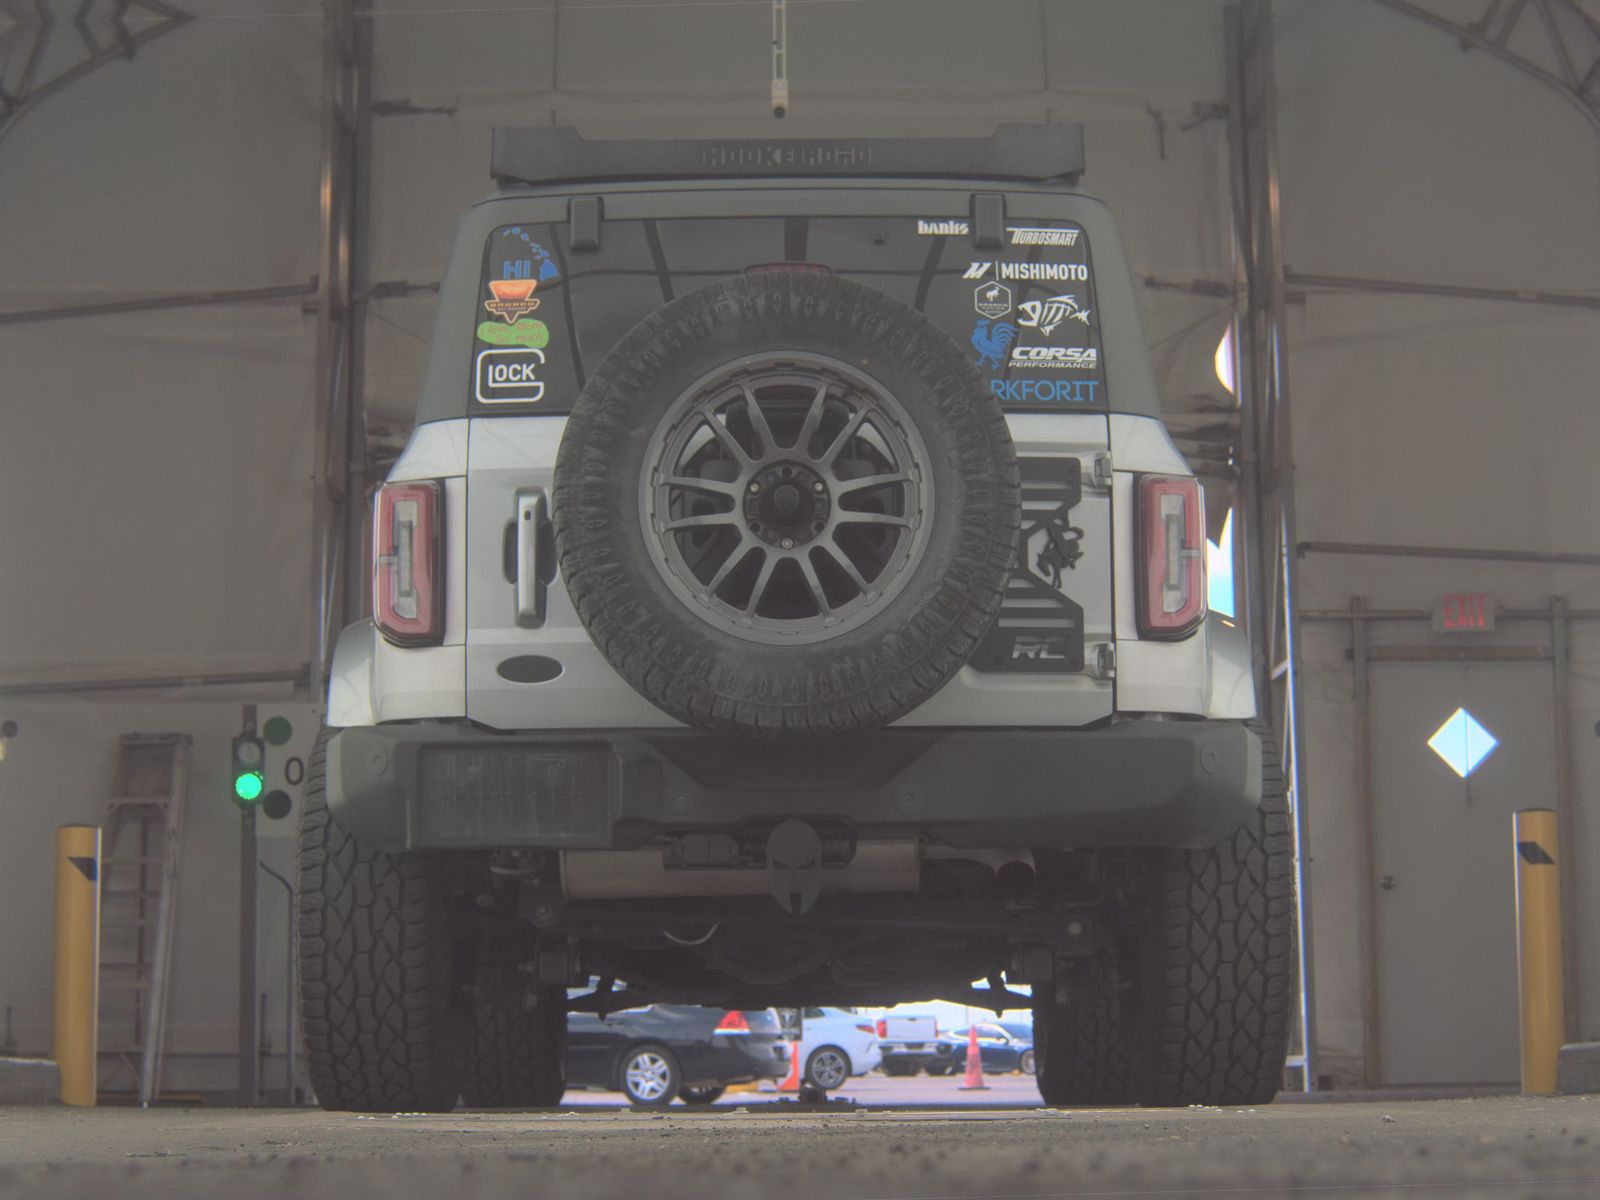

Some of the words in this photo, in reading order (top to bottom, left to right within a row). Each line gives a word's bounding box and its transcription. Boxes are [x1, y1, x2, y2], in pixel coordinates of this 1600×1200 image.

[917, 220, 970, 236] banks
[1005, 227, 1080, 247] TURBOSMART
[503, 260, 531, 279] HI
[1001, 263, 1088, 281] MISHIMOTO
[1011, 346, 1097, 361] CORSA
[1008, 360, 1097, 369] PERFORMANCE
[1443, 593, 1486, 628] EXIT
